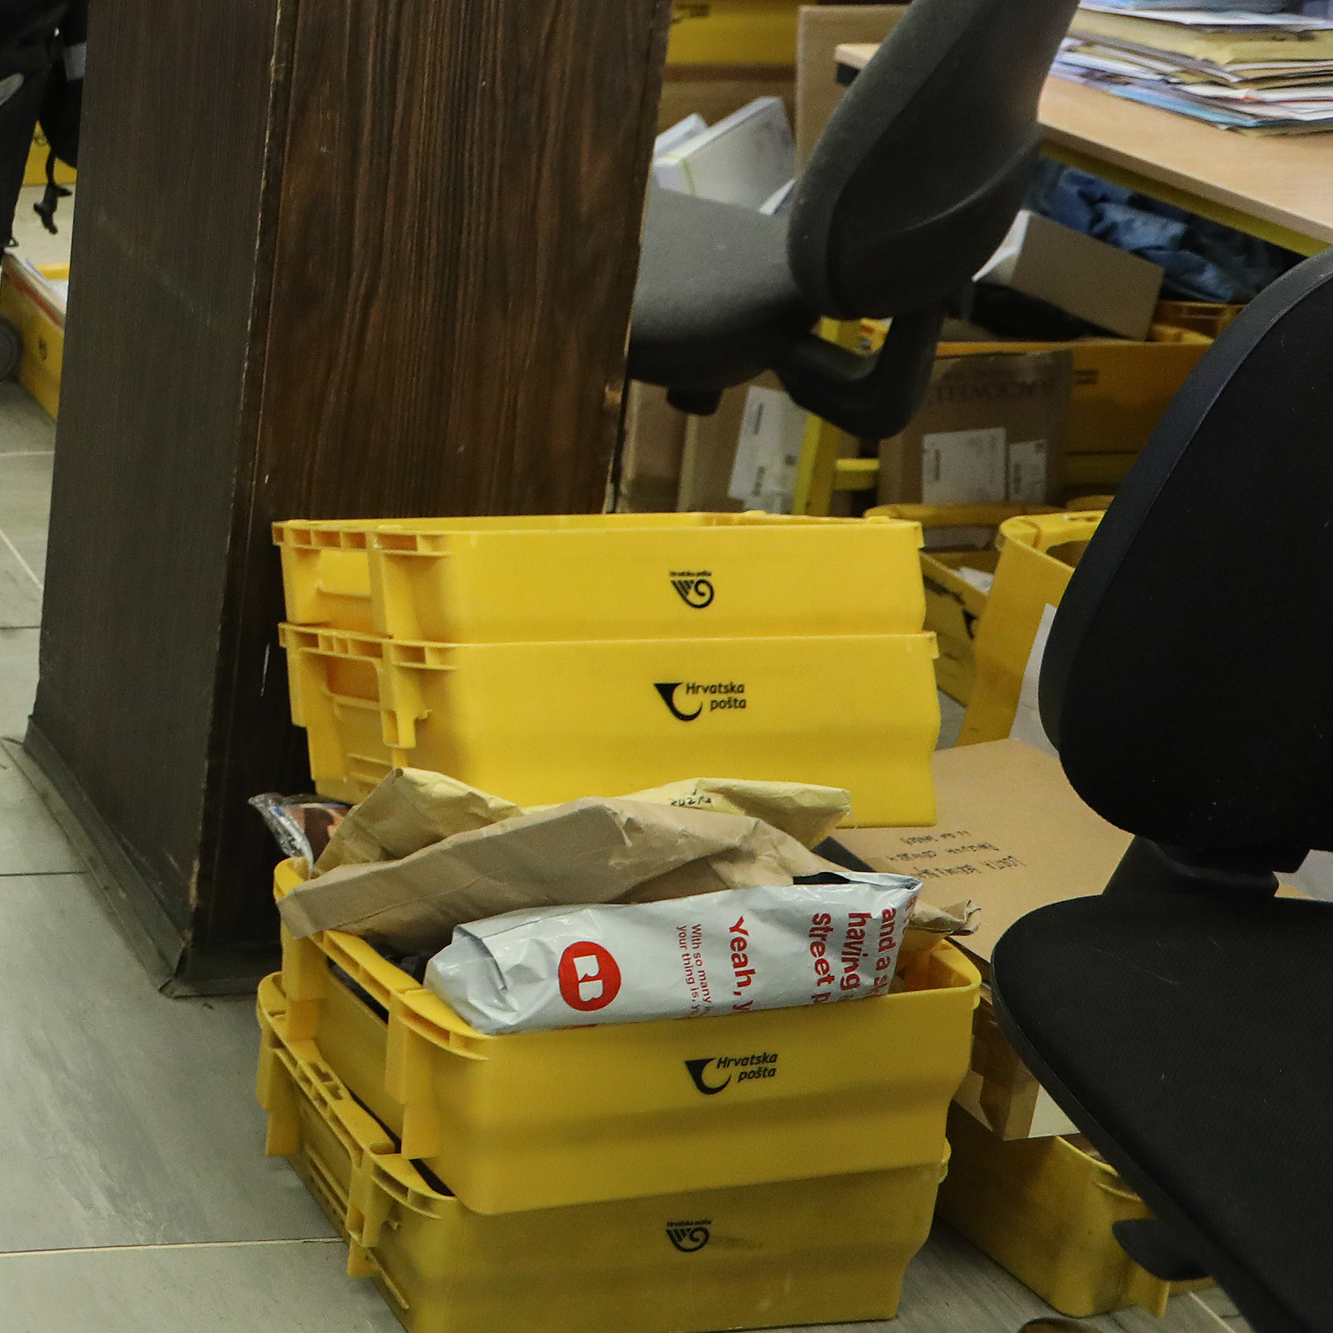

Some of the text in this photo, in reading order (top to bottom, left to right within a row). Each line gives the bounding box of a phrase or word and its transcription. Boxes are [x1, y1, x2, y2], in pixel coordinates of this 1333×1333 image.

[686, 681, 745, 695] Hrvatska
[710, 697, 747, 712] pošta
[676, 925, 687, 949] your
[876, 908, 896, 954] and
[691, 924, 712, 1005] With so many
[729, 916, 756, 995] Yeah,
[808, 912, 833, 987] street
[839, 912, 871, 990] having
[680, 952, 695, 985] thing
[717, 1052, 778, 1069] Hrvatska
[738, 1066, 776, 1083] pošta
